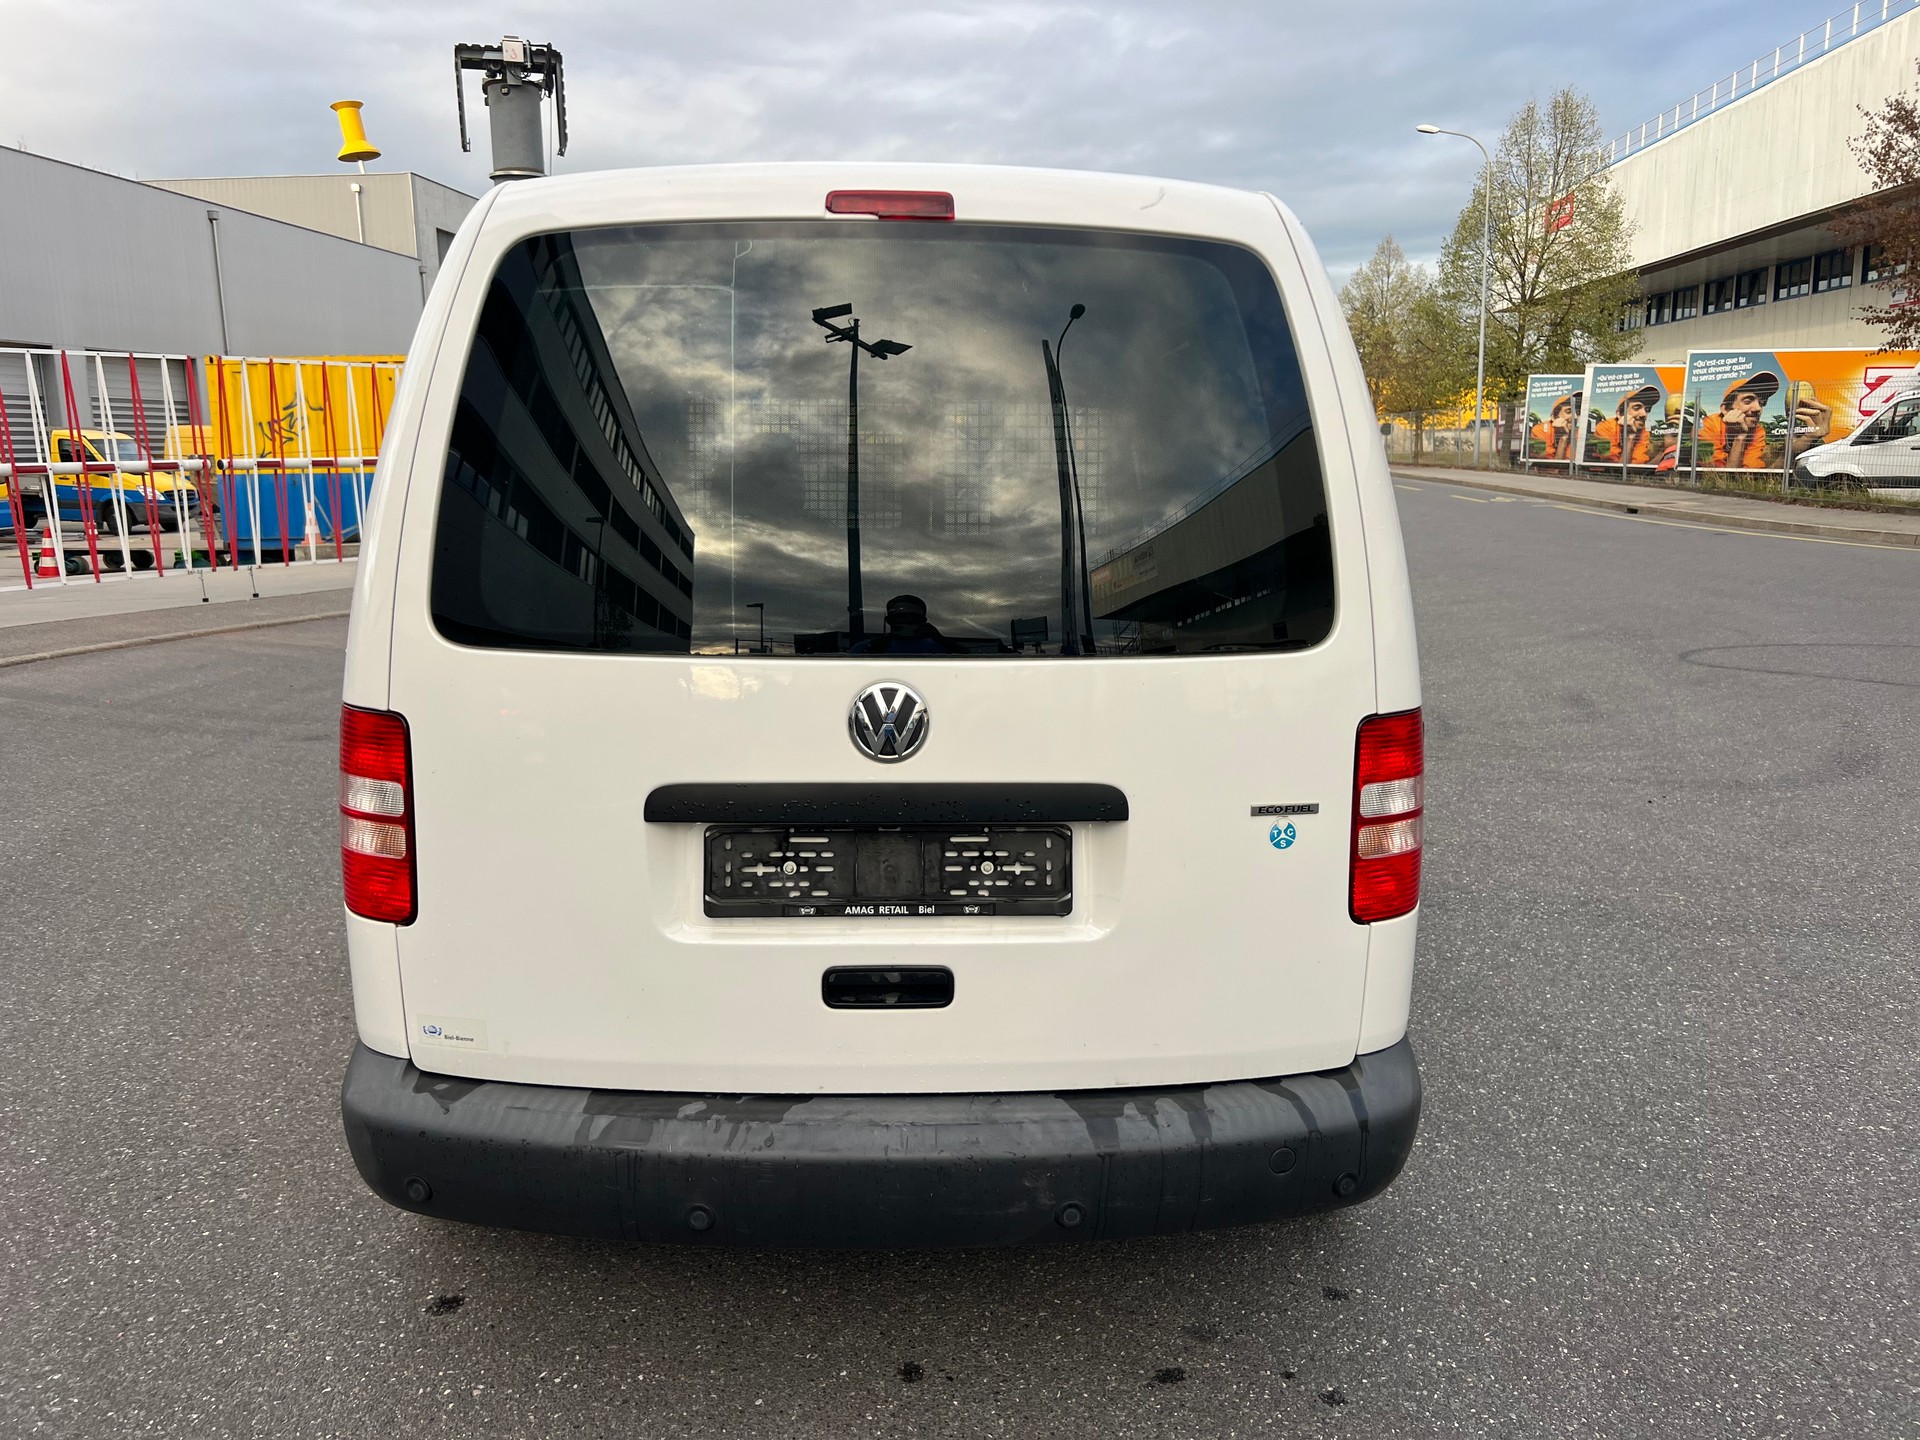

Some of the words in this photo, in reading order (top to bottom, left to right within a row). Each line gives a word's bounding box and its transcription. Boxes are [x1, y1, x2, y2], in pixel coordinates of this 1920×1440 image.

[1708, 365, 1731, 373] devenir
[1732, 362, 1752, 371] quand
[1716, 372, 1738, 381] grande
[844, 906, 874, 914] AMAG
[879, 906, 909, 914] RETAIL
[918, 905, 934, 914] Biel
